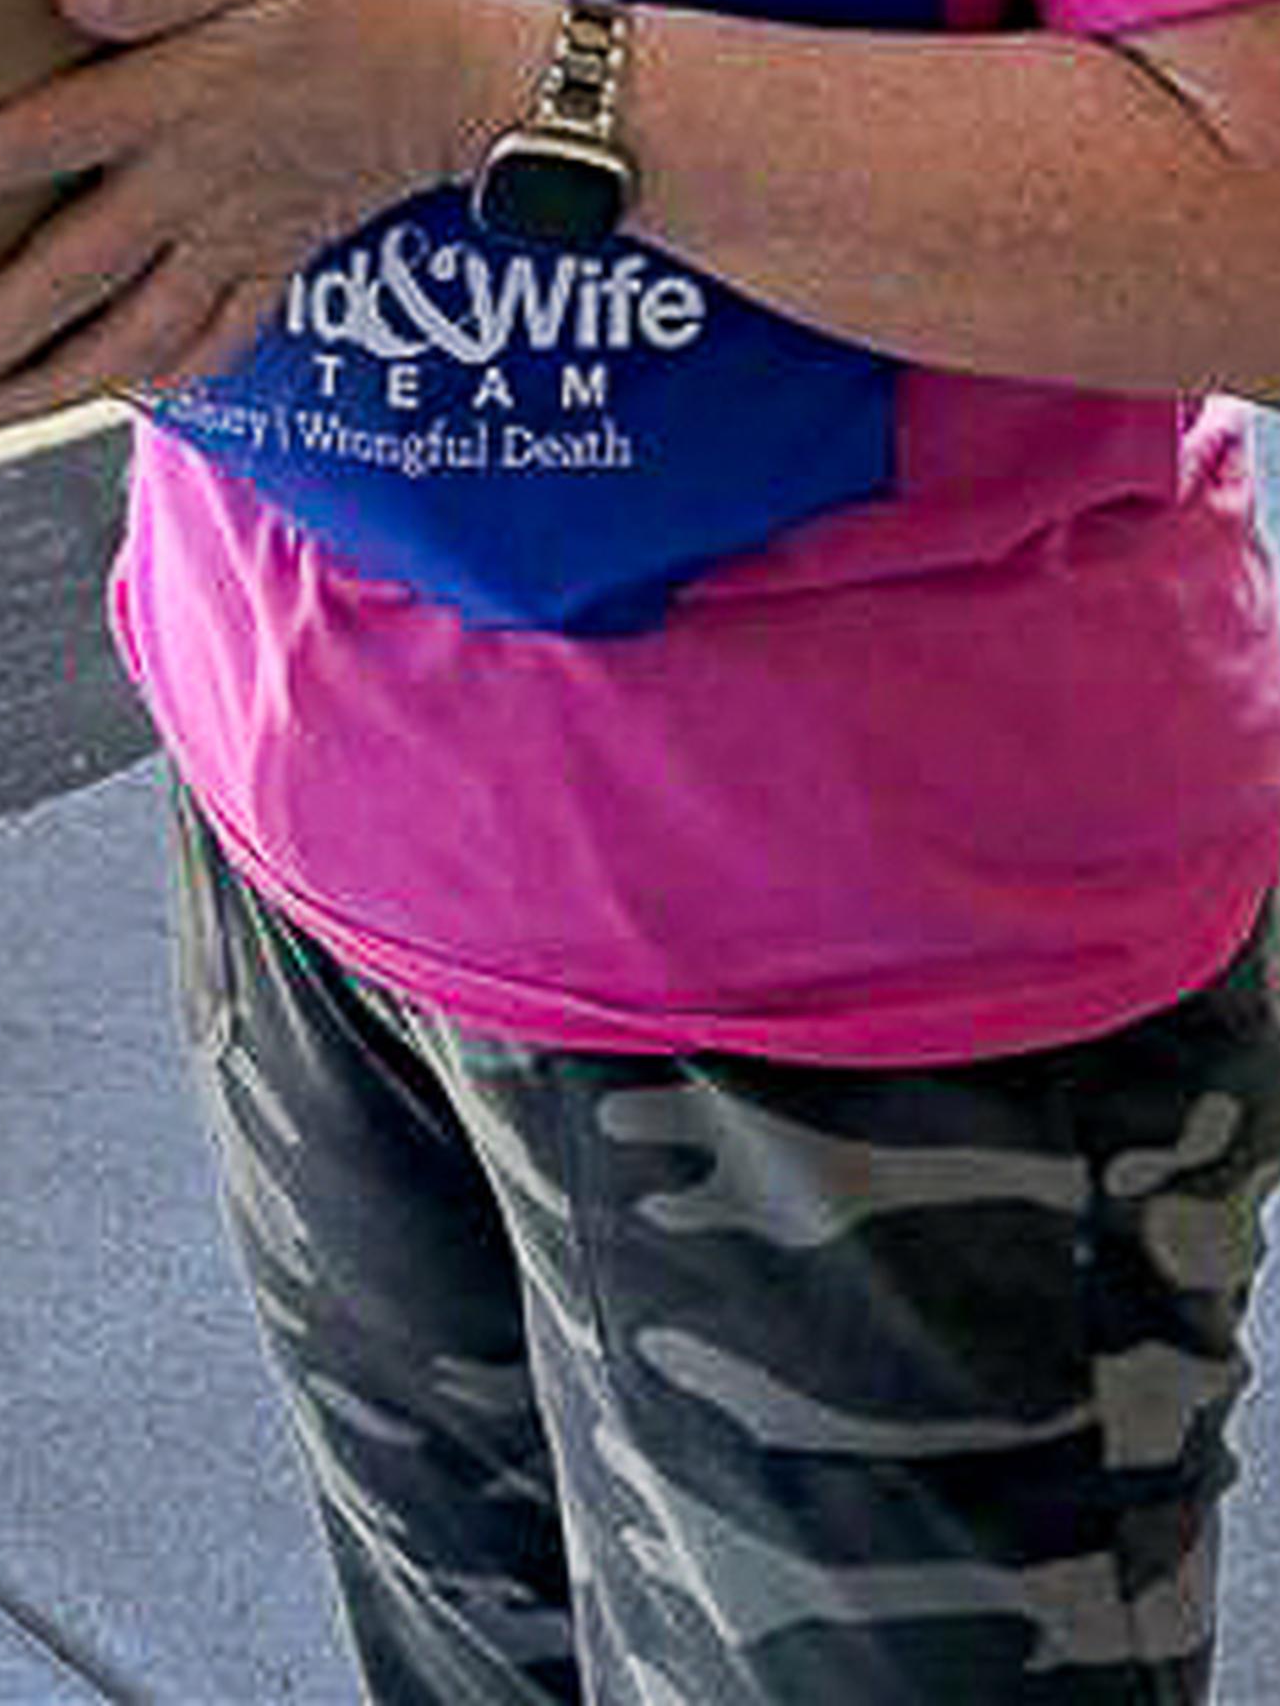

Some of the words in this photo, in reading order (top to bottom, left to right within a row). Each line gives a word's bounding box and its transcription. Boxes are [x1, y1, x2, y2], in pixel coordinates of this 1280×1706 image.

[314, 352, 607, 410] TEAM
[296, 411, 488, 478] Wrongful
[503, 416, 631, 468] Death
